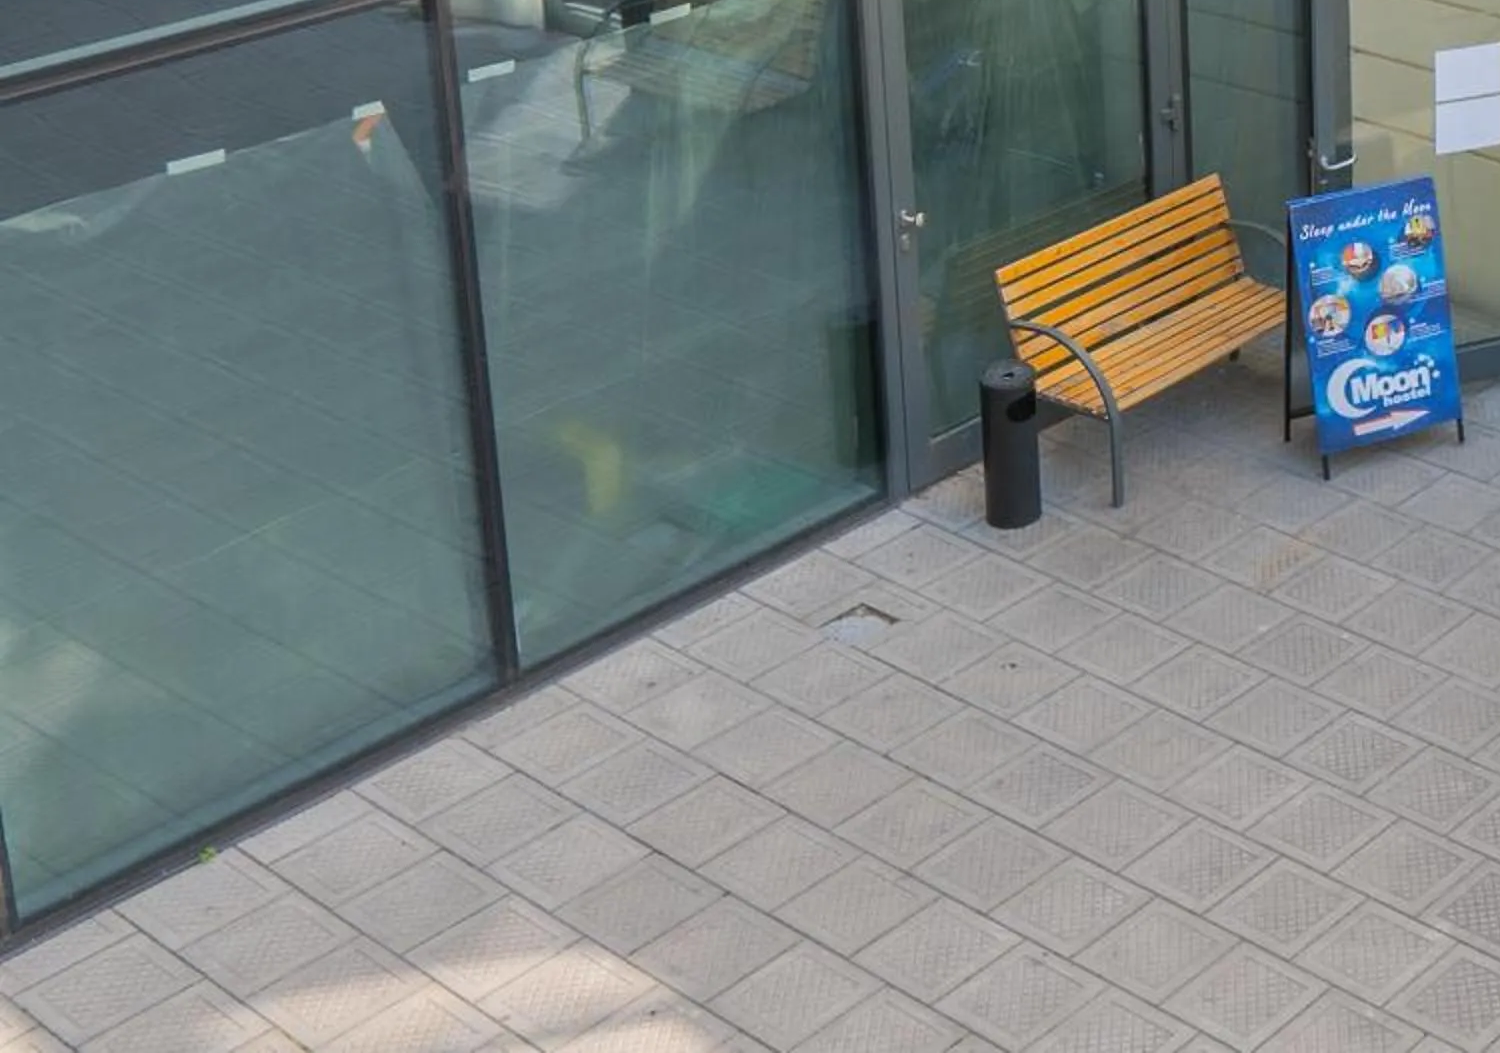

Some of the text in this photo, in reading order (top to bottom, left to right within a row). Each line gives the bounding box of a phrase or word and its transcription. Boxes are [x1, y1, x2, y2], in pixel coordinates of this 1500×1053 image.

[1299, 224, 1335, 241] Sleep
[1338, 213, 1374, 231] under
[1378, 207, 1397, 222] the
[1350, 365, 1431, 405] Moon
[1383, 384, 1431, 408] hostel
